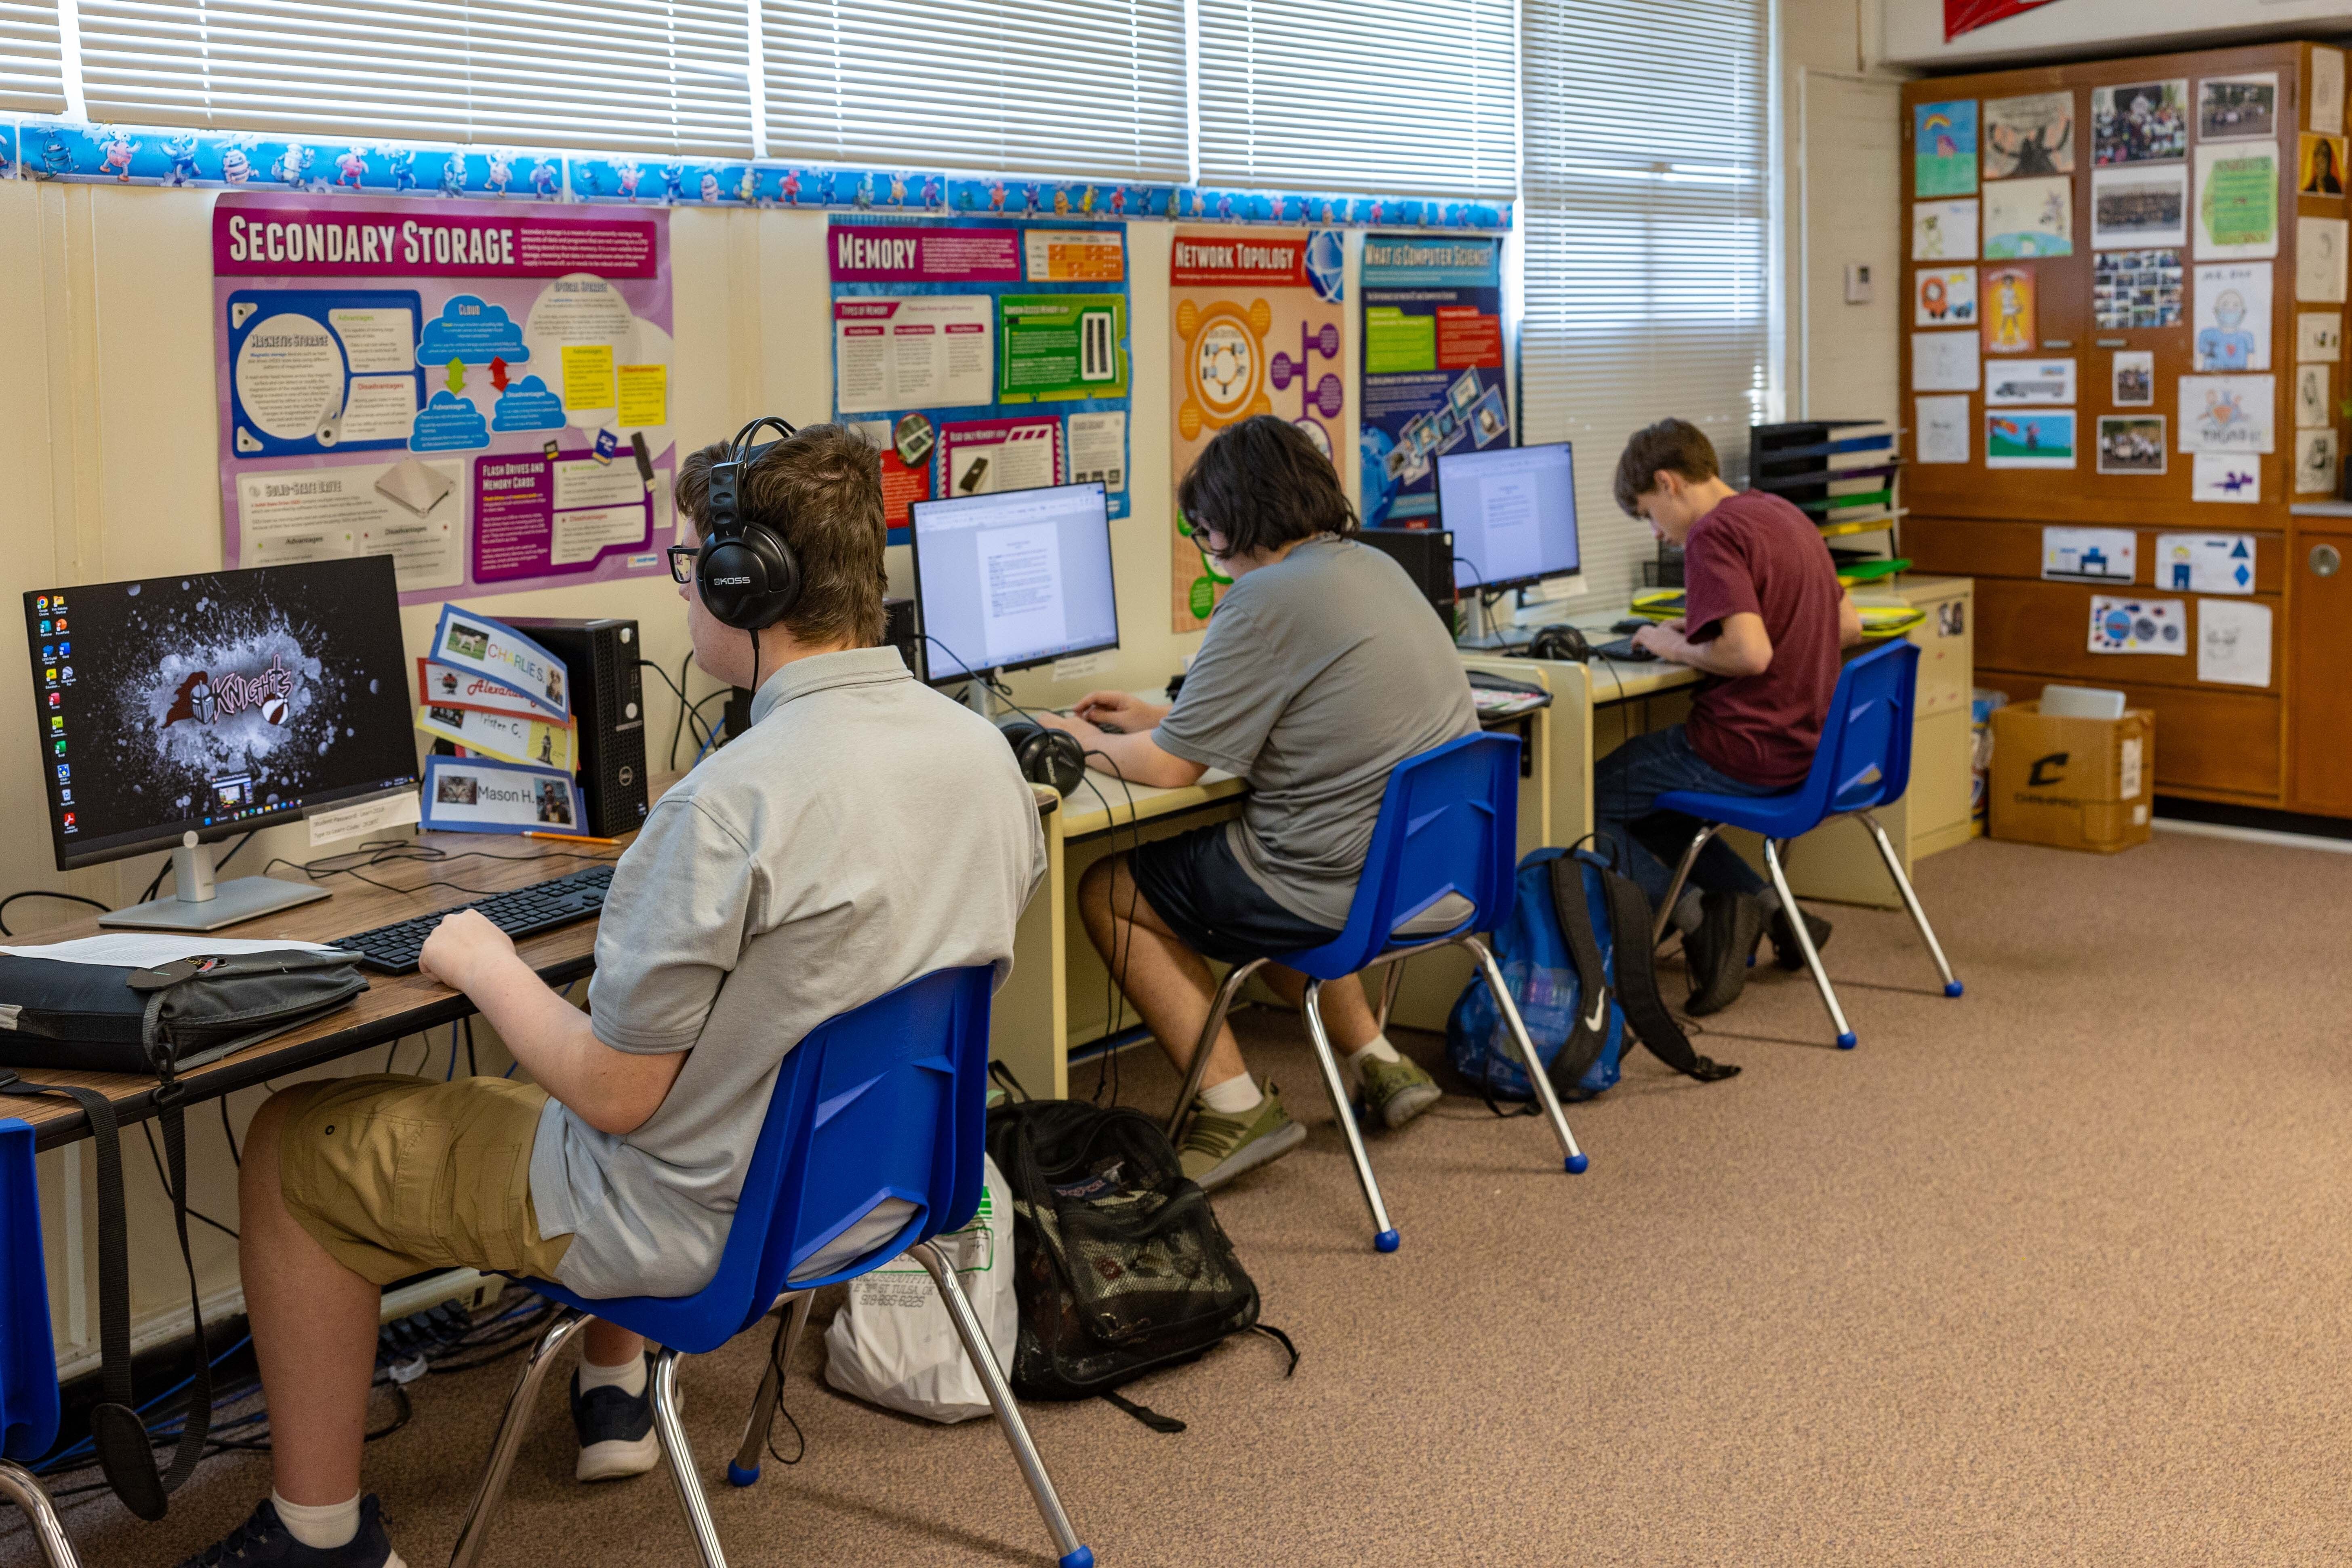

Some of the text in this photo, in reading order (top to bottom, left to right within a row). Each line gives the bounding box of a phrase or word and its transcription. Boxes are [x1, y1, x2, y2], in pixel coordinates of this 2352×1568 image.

[229, 215, 396, 263] SECONDARY
[402, 220, 515, 266] STORAGE
[838, 233, 917, 270] MEMORY
[1175, 242, 1295, 269] NETWORK TOPOLOGY
[1365, 244, 1392, 266] WHAT
[1403, 244, 1453, 266] COMPUTER
[251, 335, 328, 348] MAGNETIC STORAGE
[482, 462, 545, 477] FLASH DRIVES AND
[483, 476, 535, 491] MEMORY CARDS
[384, 526, 427, 536] Disadvantages
[285, 535, 323, 546] Advantages
[720, 577, 750, 585] KOSS
[511, 723, 522, 739] C.
[477, 787, 535, 804] Mason H.
